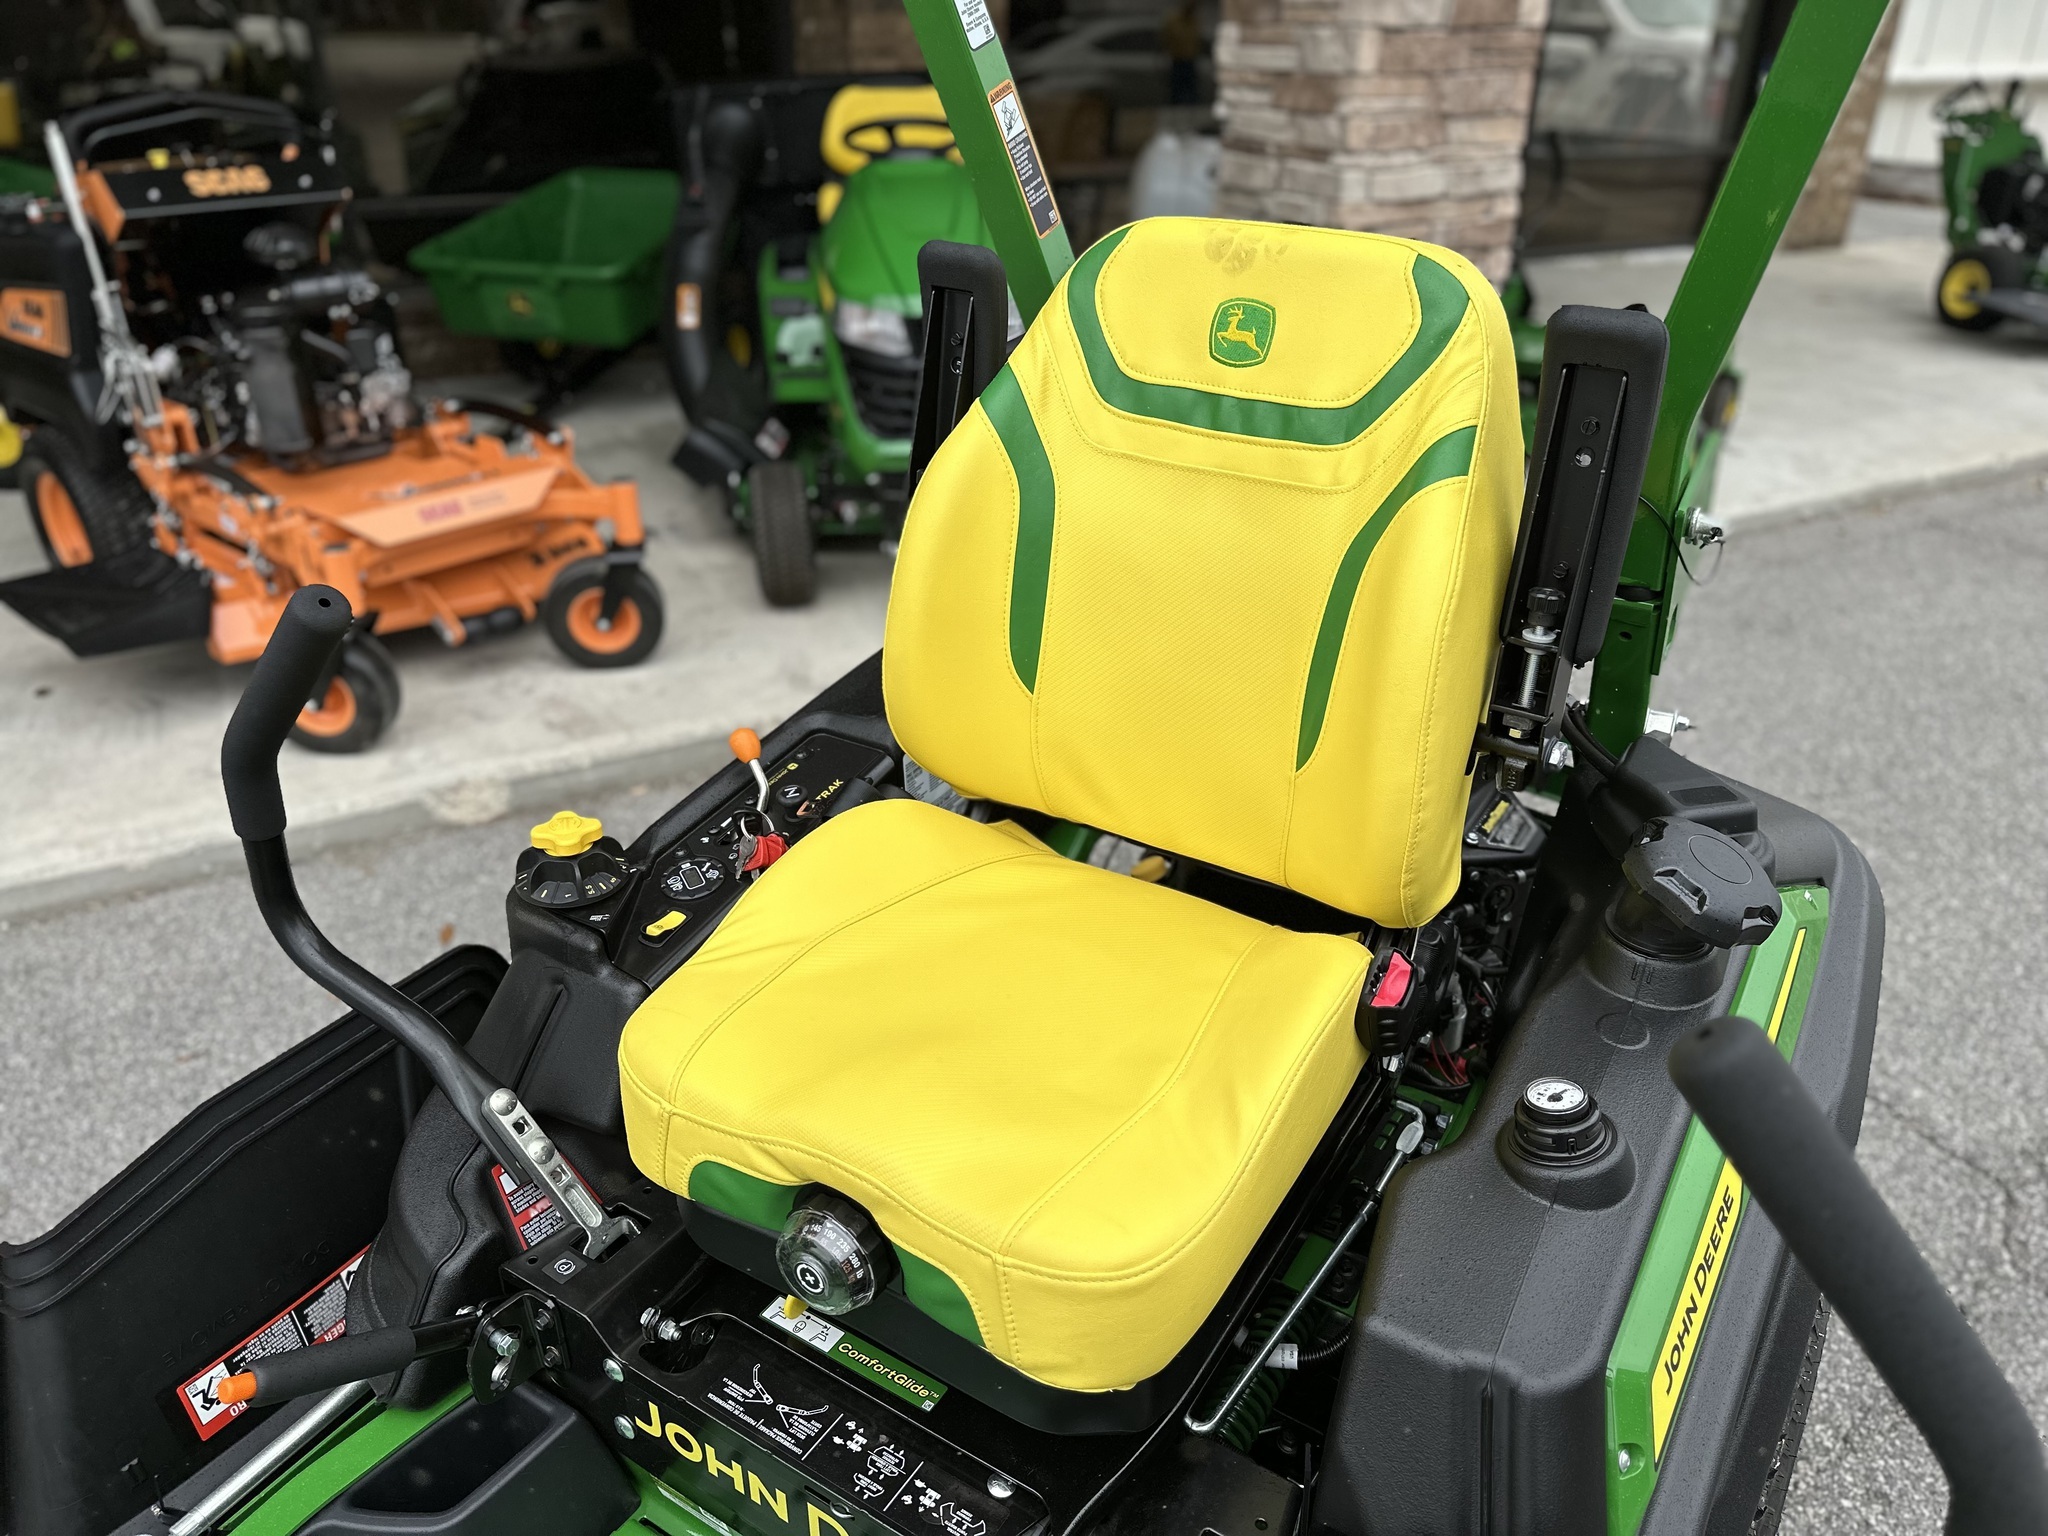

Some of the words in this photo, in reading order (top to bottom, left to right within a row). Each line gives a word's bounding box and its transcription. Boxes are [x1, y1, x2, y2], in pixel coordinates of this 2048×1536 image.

[823, 1228, 838, 1240] 190
[836, 1238, 851, 1253] 235
[849, 1252, 861, 1269] 280
[855, 1268, 865, 1279] lb
[1666, 1294, 1698, 1395] JOHN
[1694, 1185, 1735, 1299] DEERE
[758, 1423, 777, 1438] PACKAGE
[775, 1435, 803, 1455] CONVENIENCE
[634, 1400, 790, 1524] JOHN
